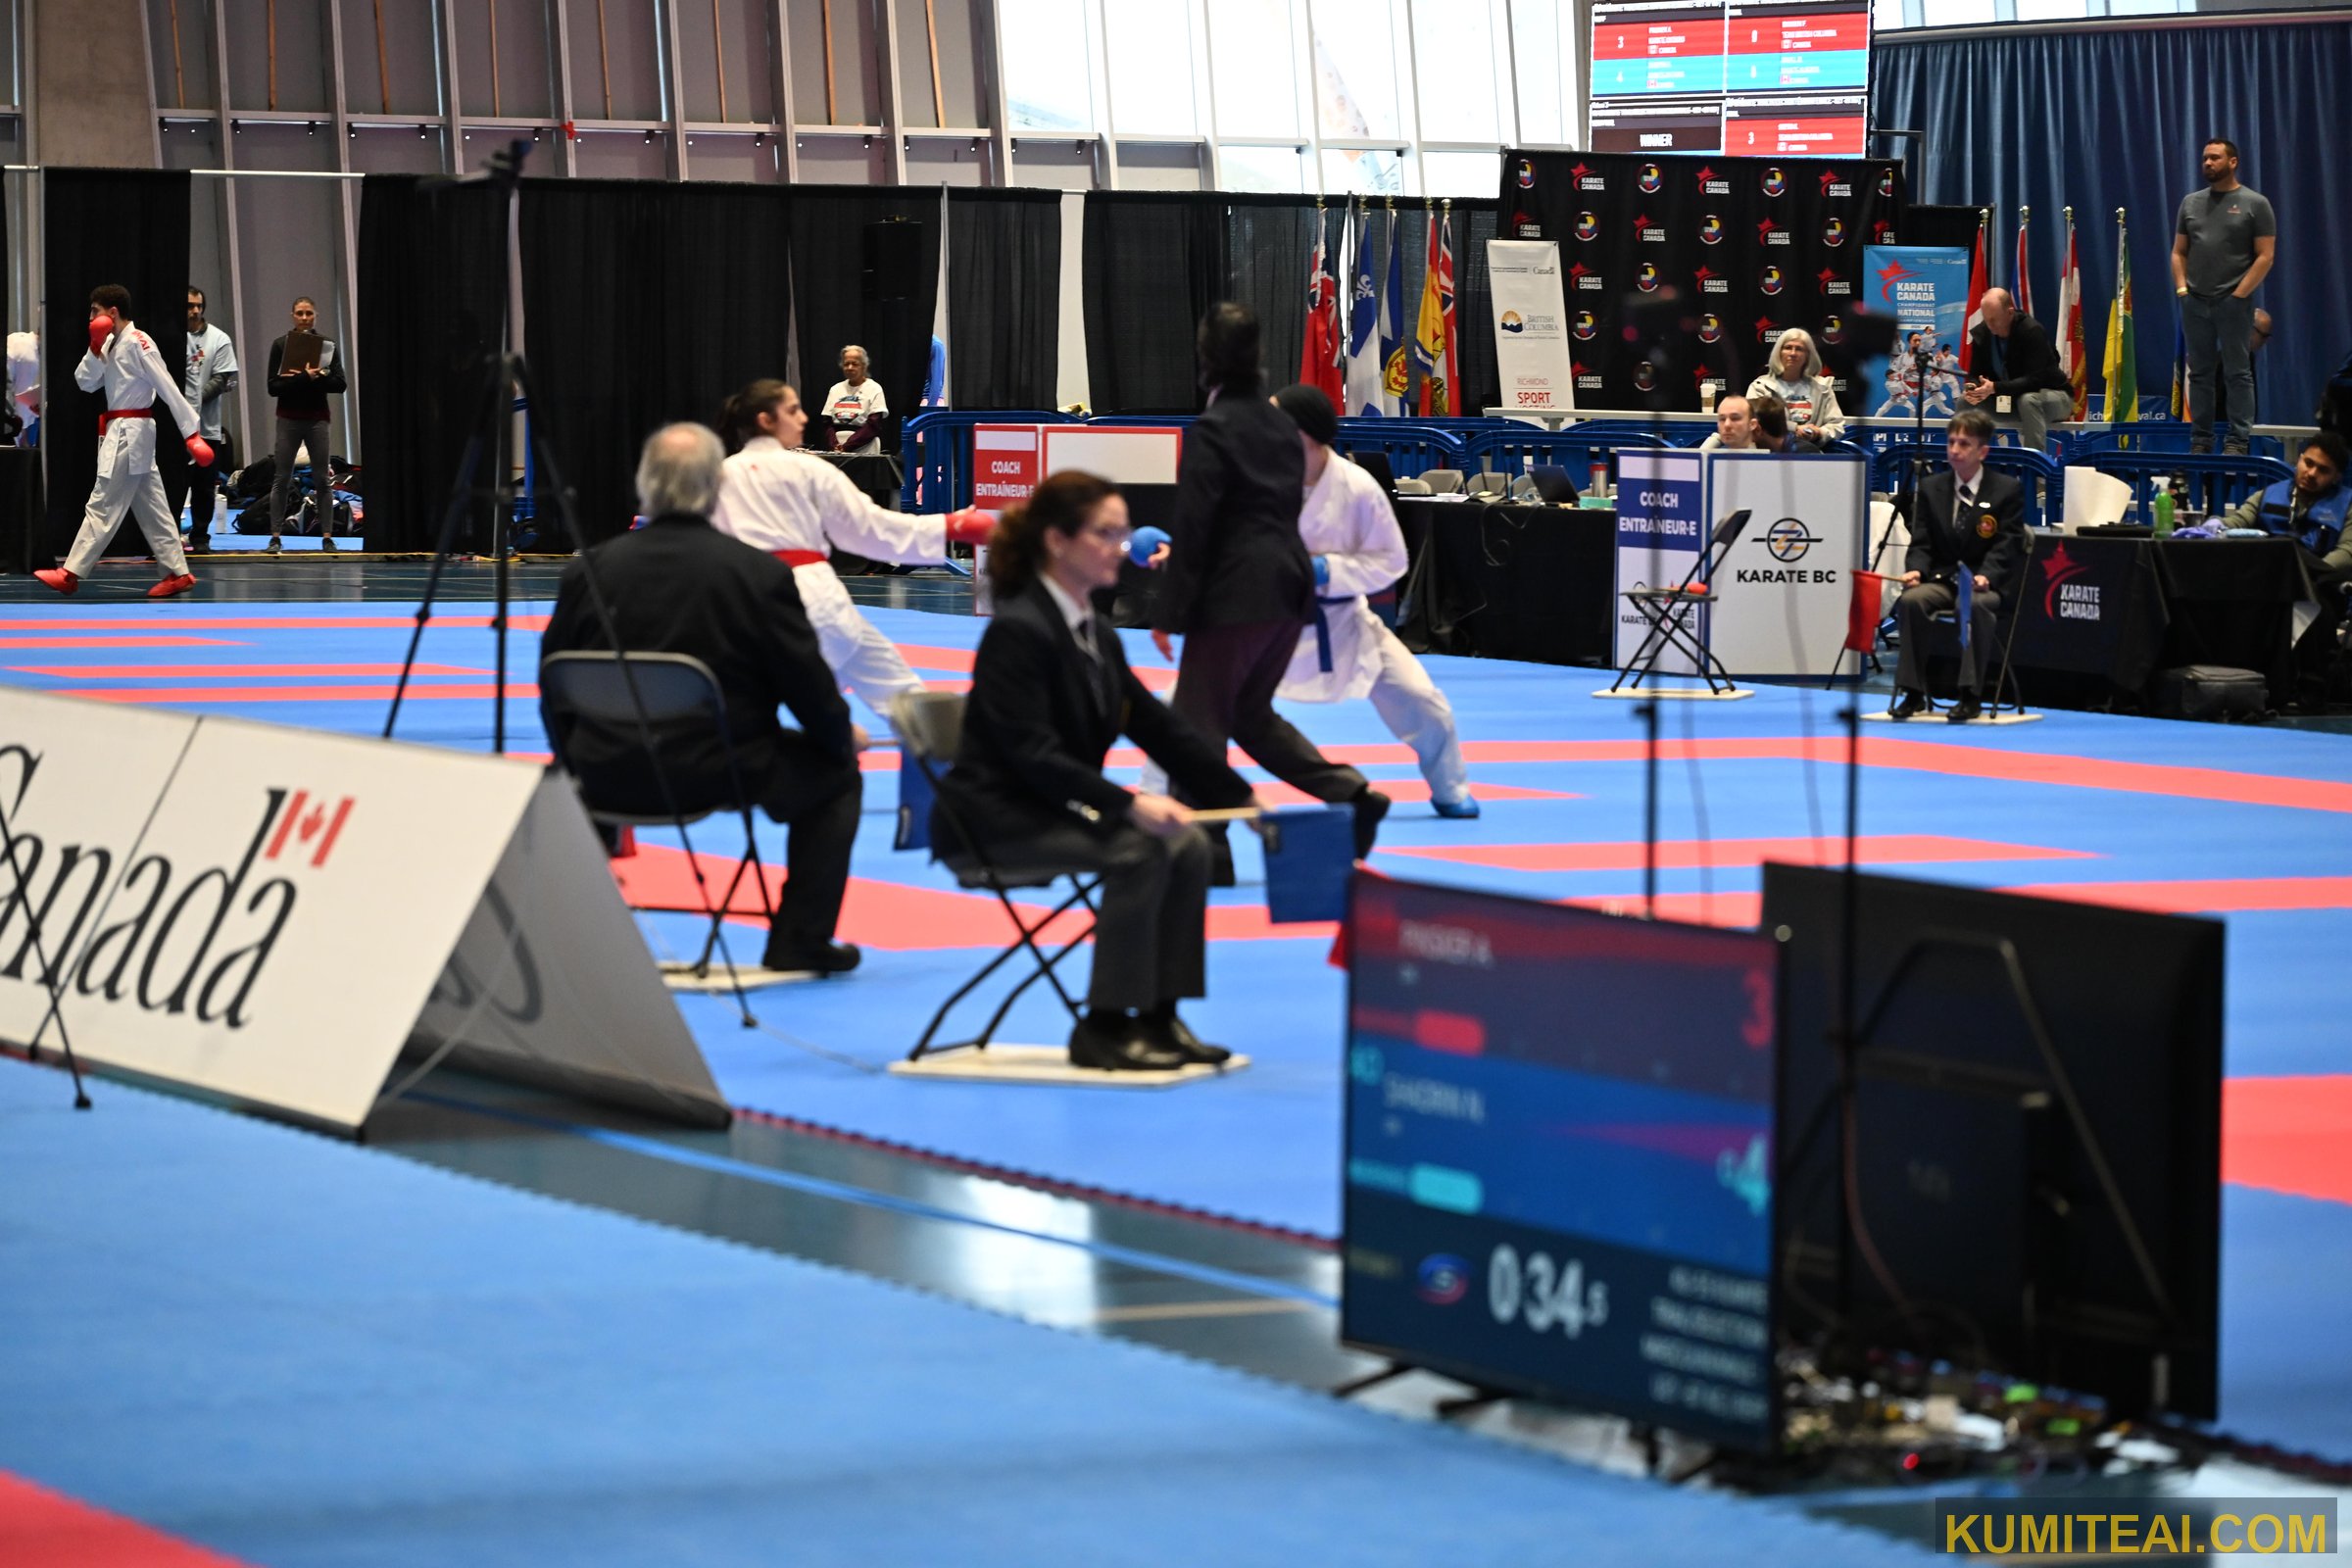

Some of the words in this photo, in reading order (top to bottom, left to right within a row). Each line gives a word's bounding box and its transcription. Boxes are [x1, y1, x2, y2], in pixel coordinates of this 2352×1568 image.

[1640, 133, 1673, 147] WINNER
[1896, 282, 1936, 292] KARATE
[1896, 292, 1936, 301] CANADA
[1527, 315, 1554, 323] BRITISH
[1524, 322, 1559, 331] COLUMBIA
[1517, 392, 1551, 404] SPORT
[992, 461, 1020, 474] COACH
[1640, 491, 1679, 509] COACH
[1737, 569, 1807, 583] KARATE
[1813, 569, 1837, 583] BC
[2060, 583, 2100, 603] KARATE
[2060, 602, 2100, 620] CANADA
